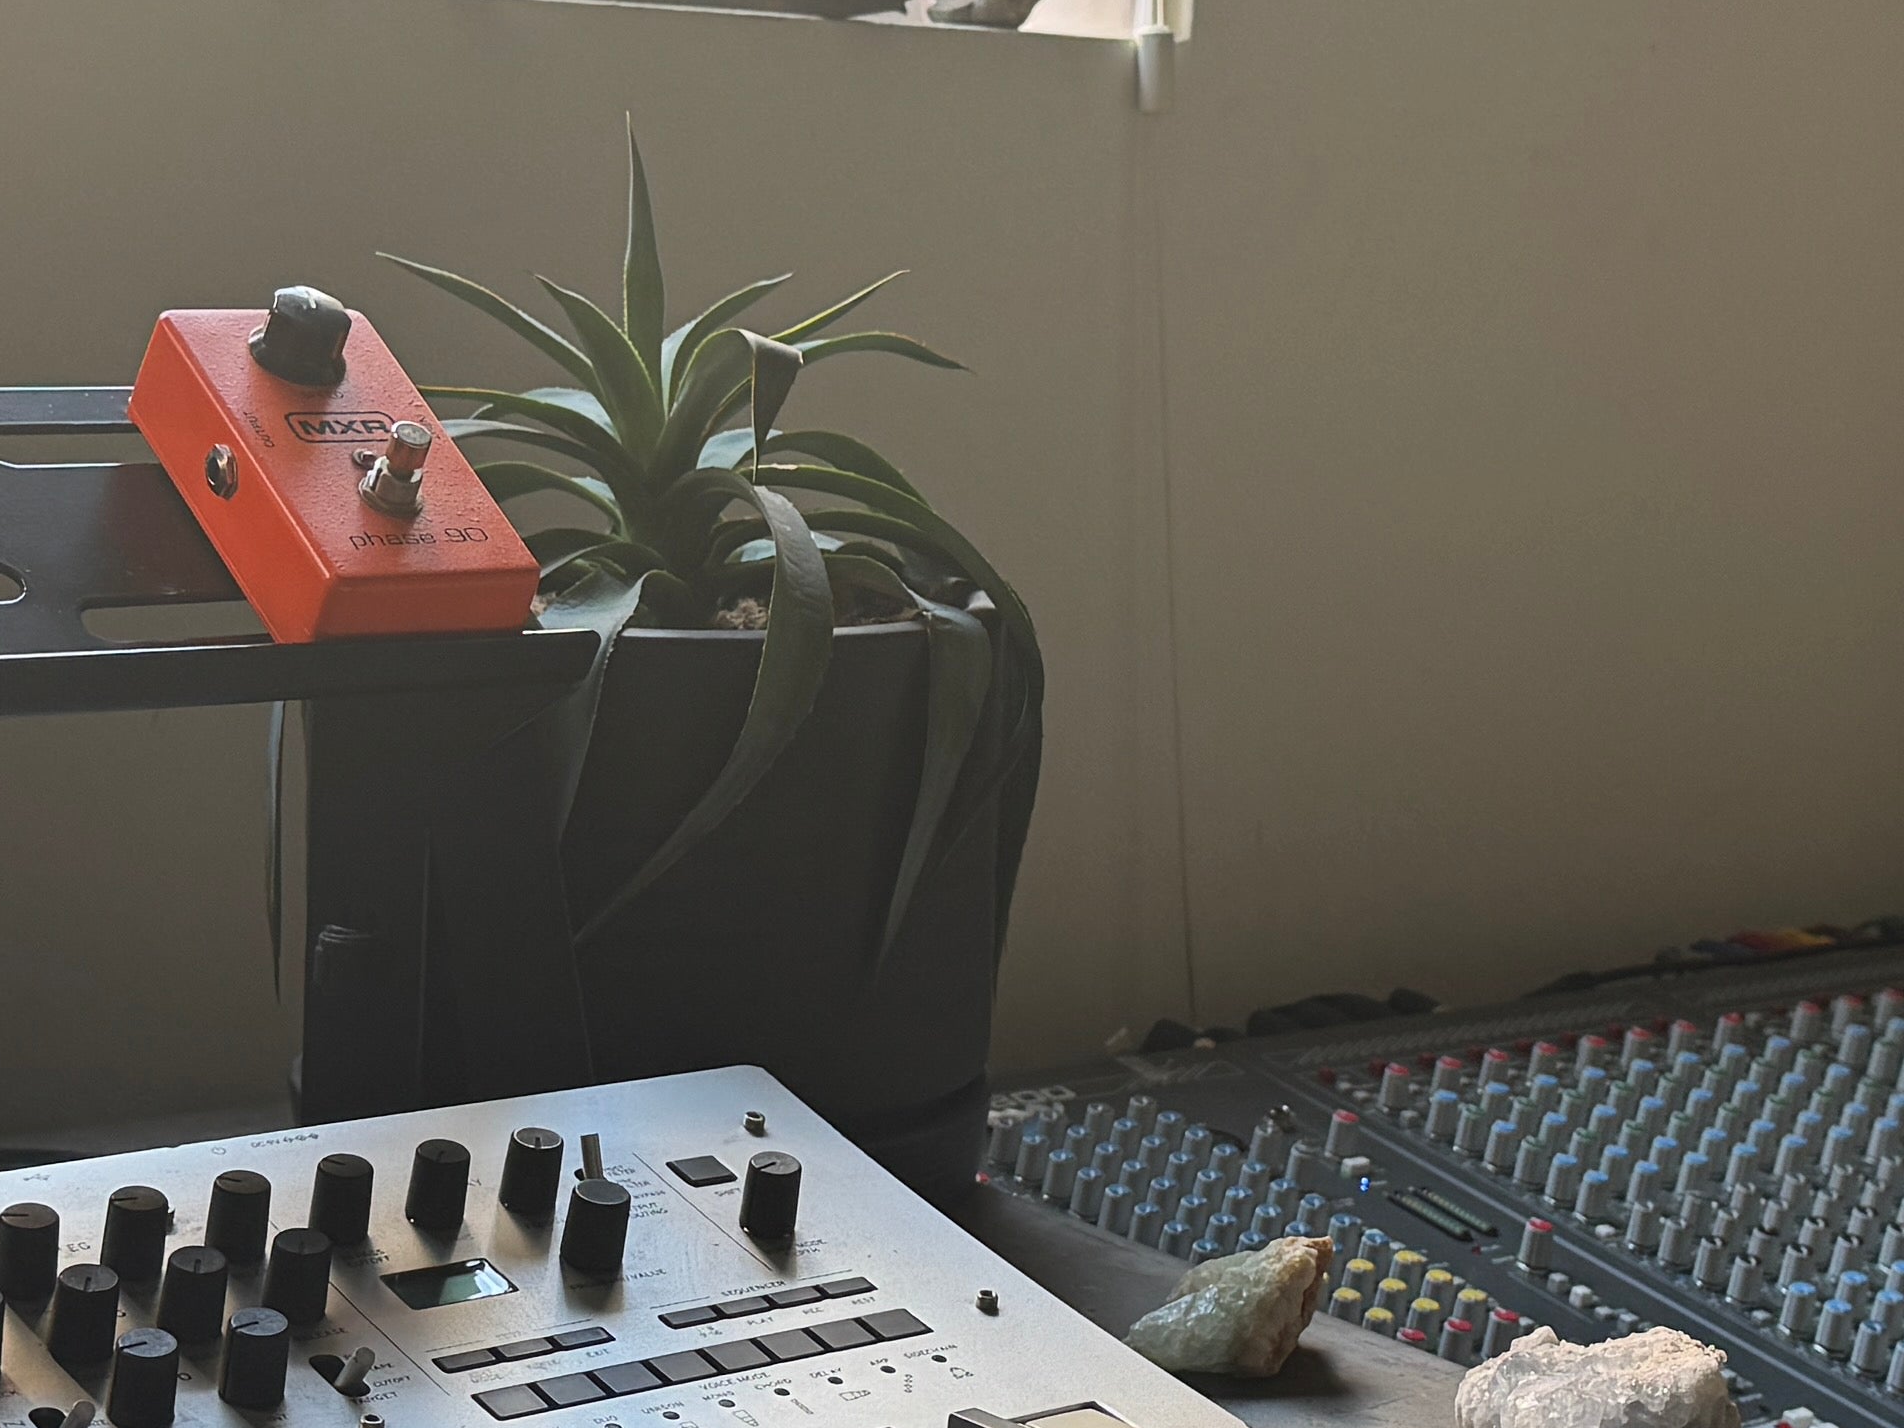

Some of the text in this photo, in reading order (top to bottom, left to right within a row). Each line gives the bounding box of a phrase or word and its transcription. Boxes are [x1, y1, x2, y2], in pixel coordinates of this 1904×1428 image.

[243, 410, 276, 449] OUTPUT
[295, 418, 393, 436] MXR
[349, 527, 490, 551] phase 90
[65, 1240, 93, 1255] EG
[720, 1280, 787, 1298] SEQUENCER
